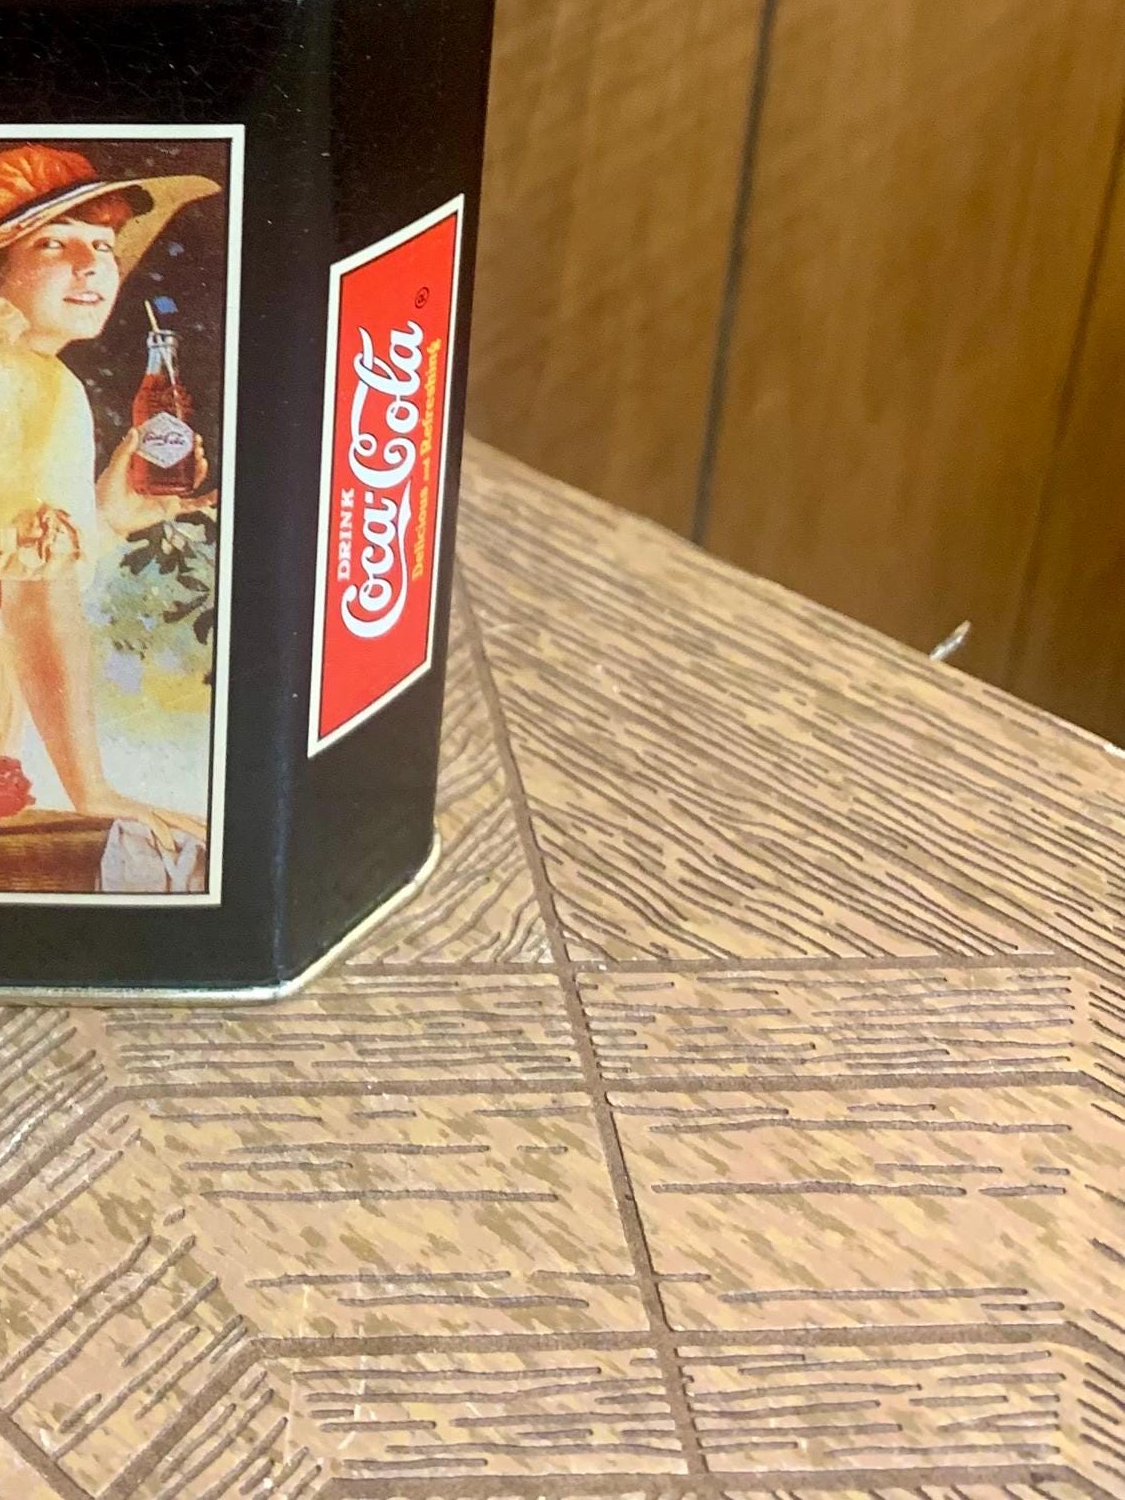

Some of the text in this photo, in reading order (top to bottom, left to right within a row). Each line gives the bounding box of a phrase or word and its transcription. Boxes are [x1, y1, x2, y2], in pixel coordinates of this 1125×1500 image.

[418, 338, 443, 456] Refreshing
[339, 320, 424, 639] Coca-Cola
[336, 487, 356, 581] DRINK
[411, 486, 431, 581] Delicious
